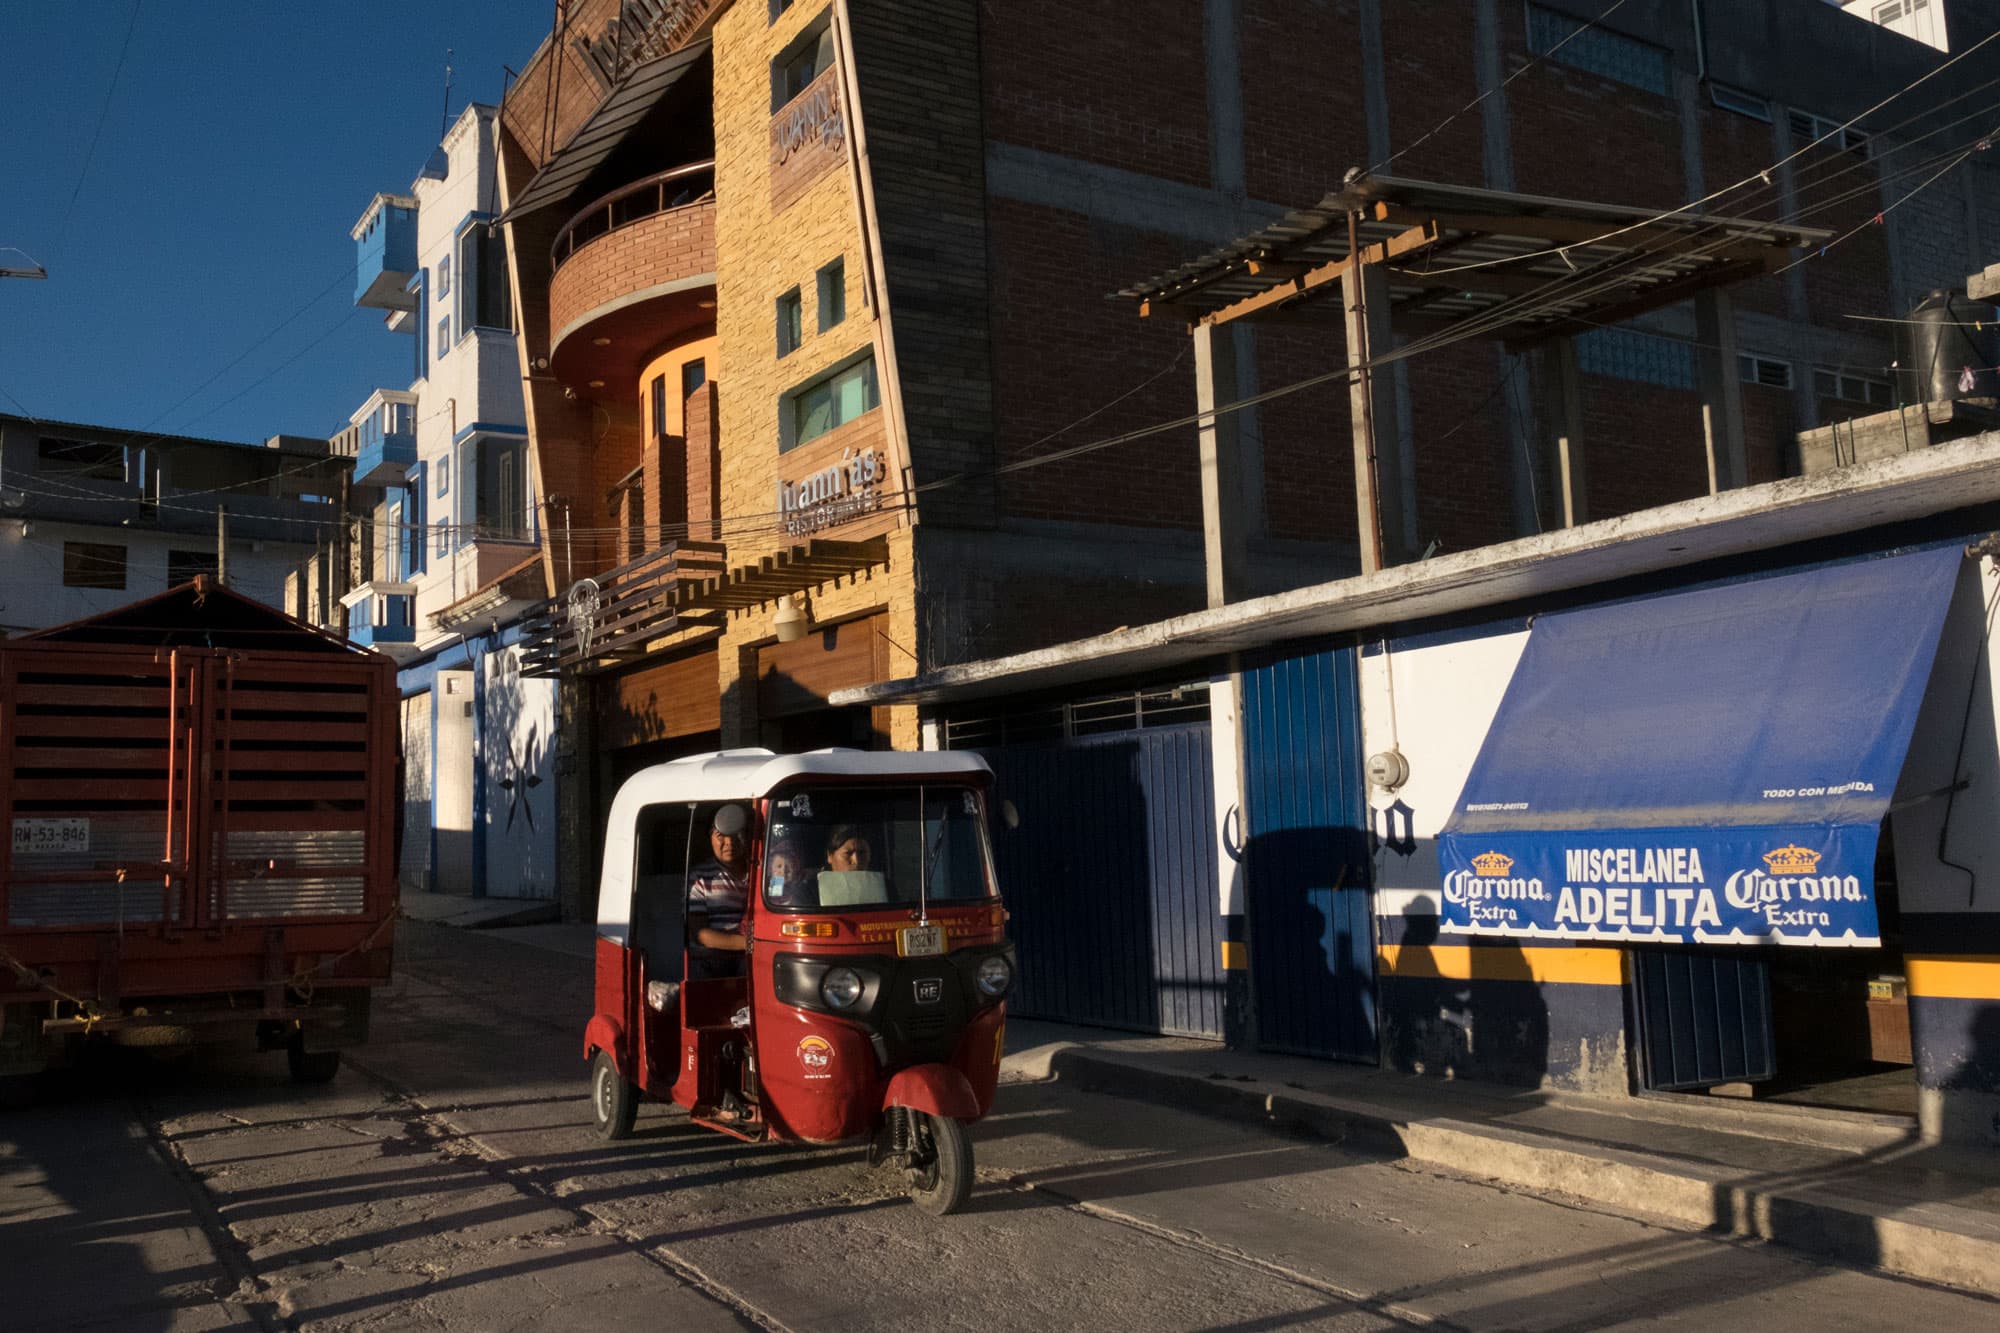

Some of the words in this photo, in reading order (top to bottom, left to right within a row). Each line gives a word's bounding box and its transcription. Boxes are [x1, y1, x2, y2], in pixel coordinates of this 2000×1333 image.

[1763, 789, 1795, 798] TODO
[1798, 786, 1825, 797] CON
[1566, 848, 1704, 883] MISCELANEA
[1443, 869, 1545, 907] Corona
[1724, 868, 1862, 913] Corona
[1468, 900, 1518, 920] Extra
[1553, 887, 1723, 927] ADELITA
[1763, 903, 1830, 926] Extra
